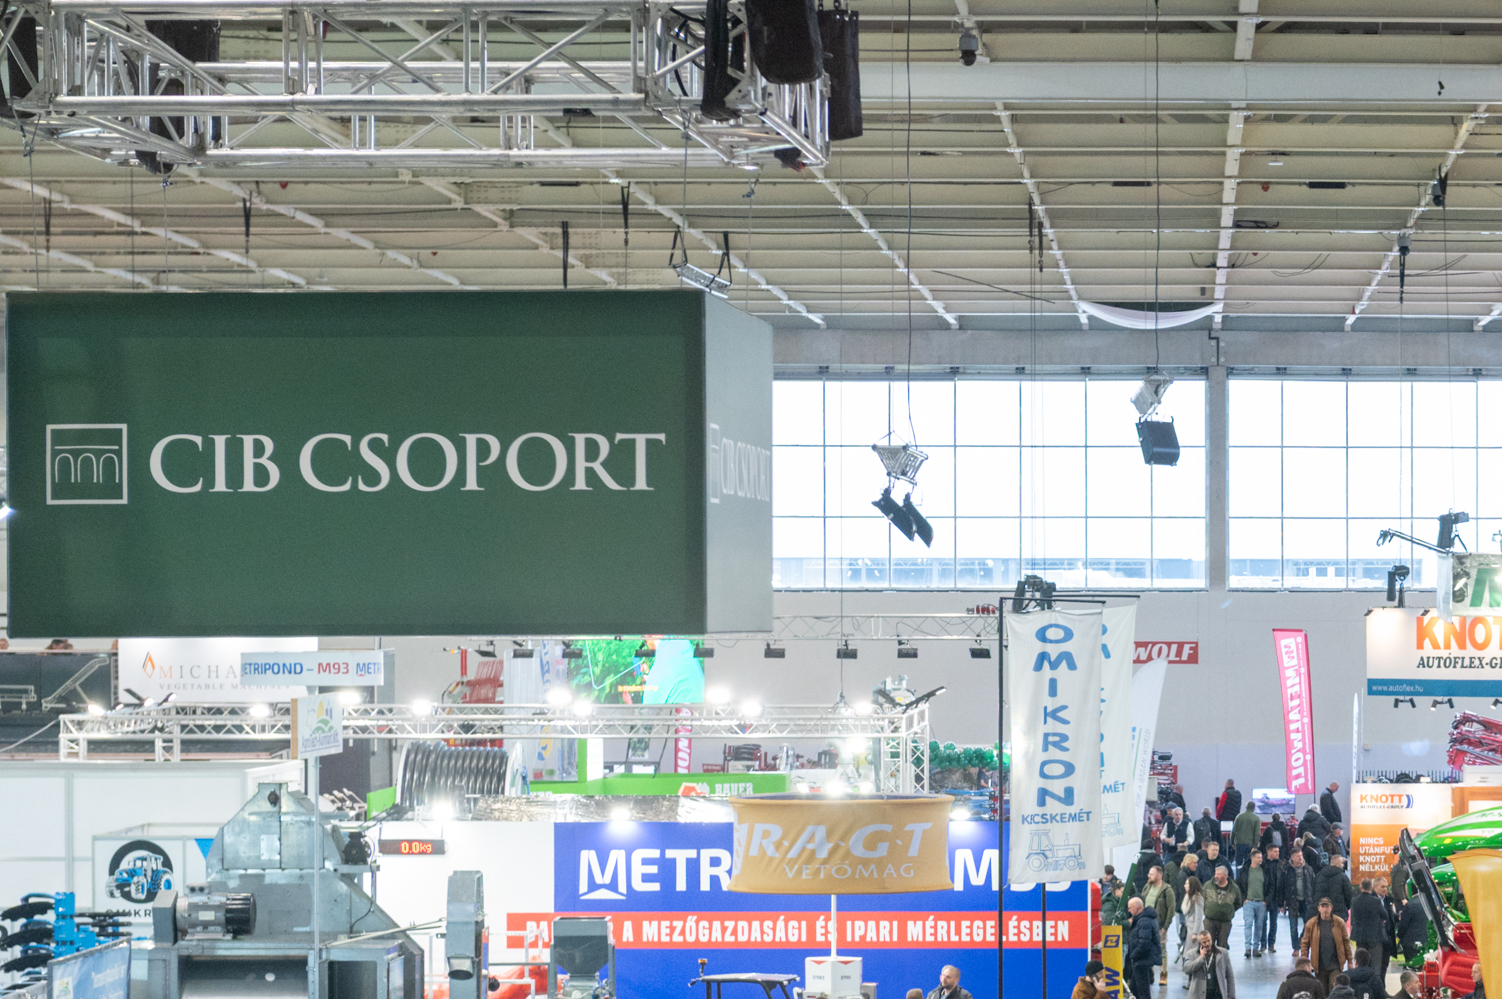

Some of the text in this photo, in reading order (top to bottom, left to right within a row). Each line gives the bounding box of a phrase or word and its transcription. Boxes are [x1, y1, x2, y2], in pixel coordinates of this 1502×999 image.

[148, 431, 667, 494] CIB CSOPORT
[159, 665, 237, 680] MICHA
[317, 662, 350, 675] M93
[159, 683, 226, 691] VEGETABLE
[1371, 684, 1424, 693] www.autoflex.hu
[1032, 623, 1078, 808] OMIKRON
[1360, 793, 1404, 804] KNOTT
[1359, 837, 1384, 845] NINCS
[1359, 845, 1395, 854] UTÁNFUT
[783, 860, 915, 880] VETŐMAG
[622, 921, 634, 942] A
[642, 915, 807, 942] MEZŐGAZDASÁGI
[847, 920, 899, 942] IPARI
[906, 915, 1070, 942] MÉRLEGEÉSBEN
